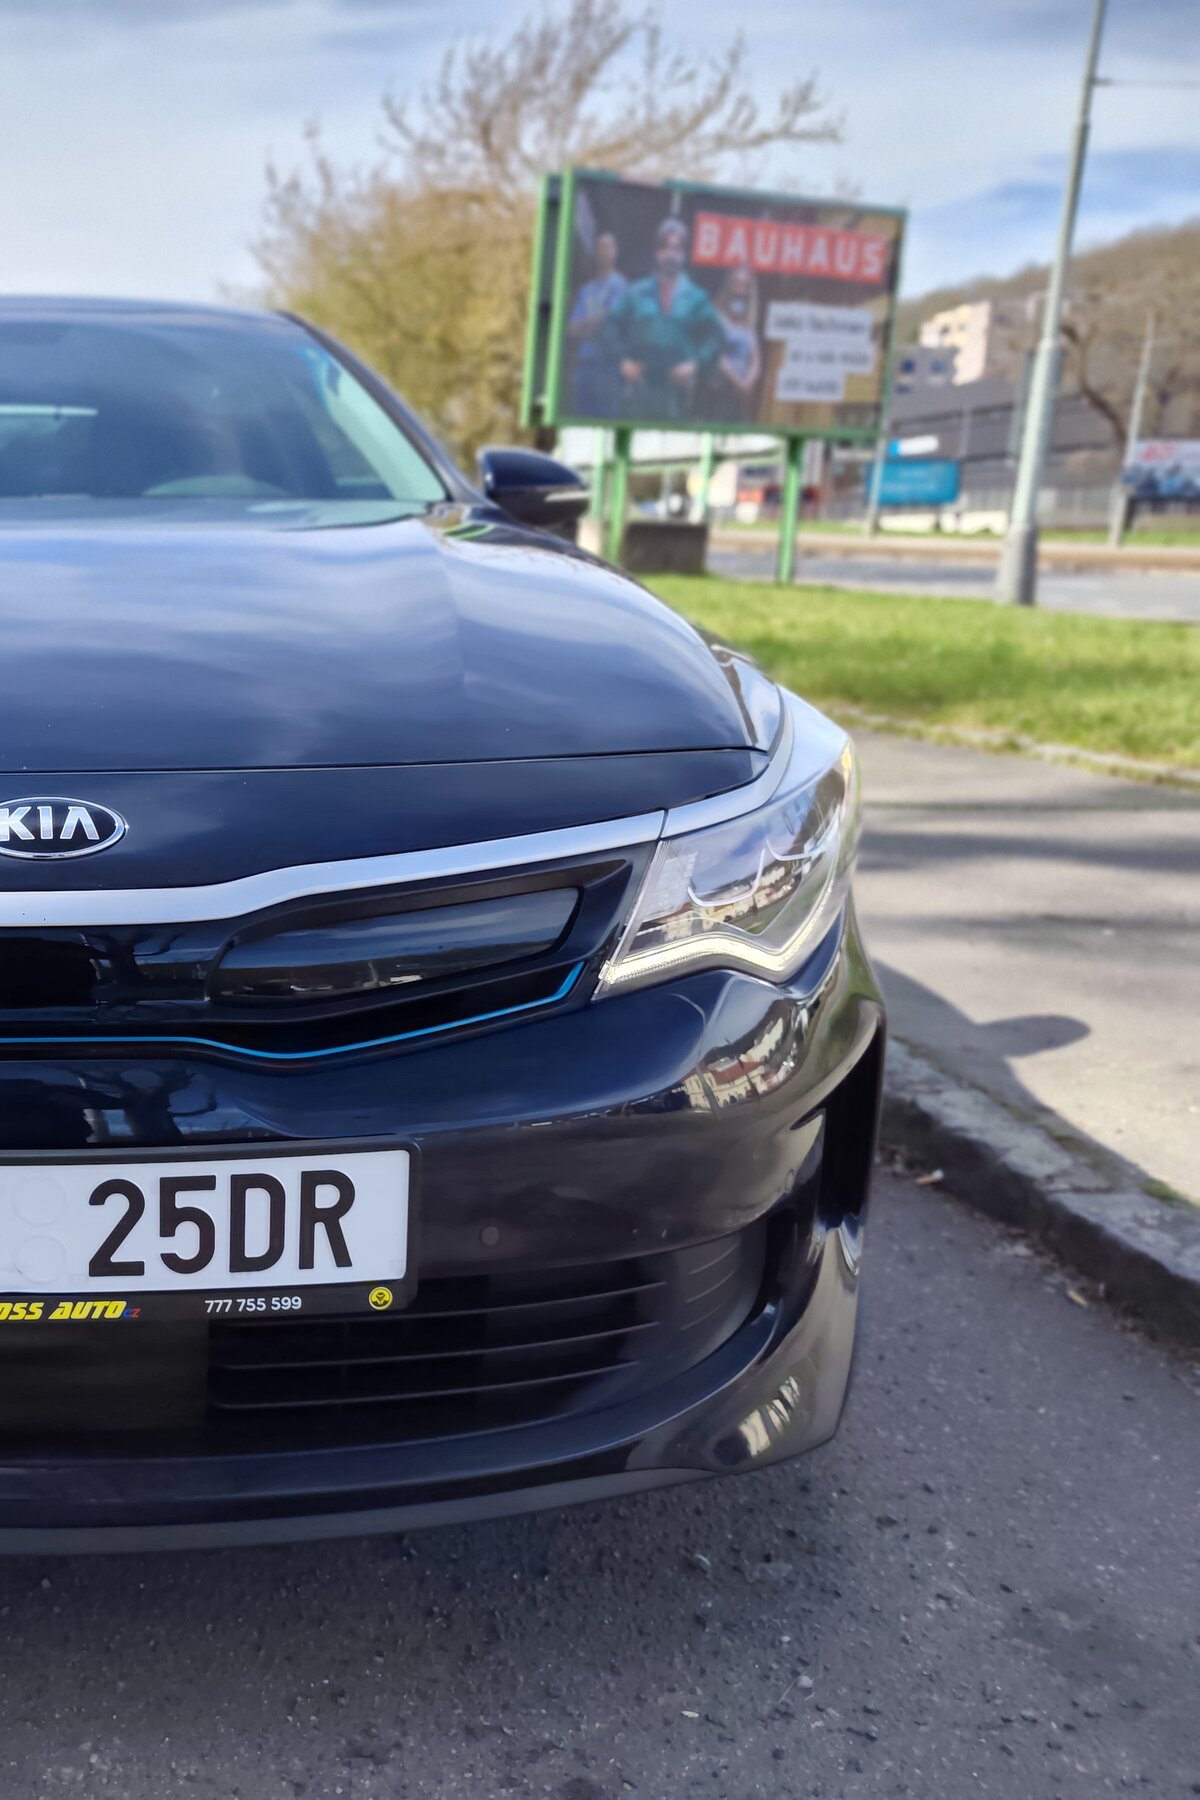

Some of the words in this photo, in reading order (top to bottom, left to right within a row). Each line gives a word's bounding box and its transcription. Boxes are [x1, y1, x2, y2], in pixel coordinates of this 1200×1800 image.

[698, 220, 883, 277] BAUHAUS
[87, 1169, 357, 1277] 25DR
[204, 1299, 233, 1314] 777
[236, 1298, 267, 1312] 755
[270, 1296, 302, 1311] 599
